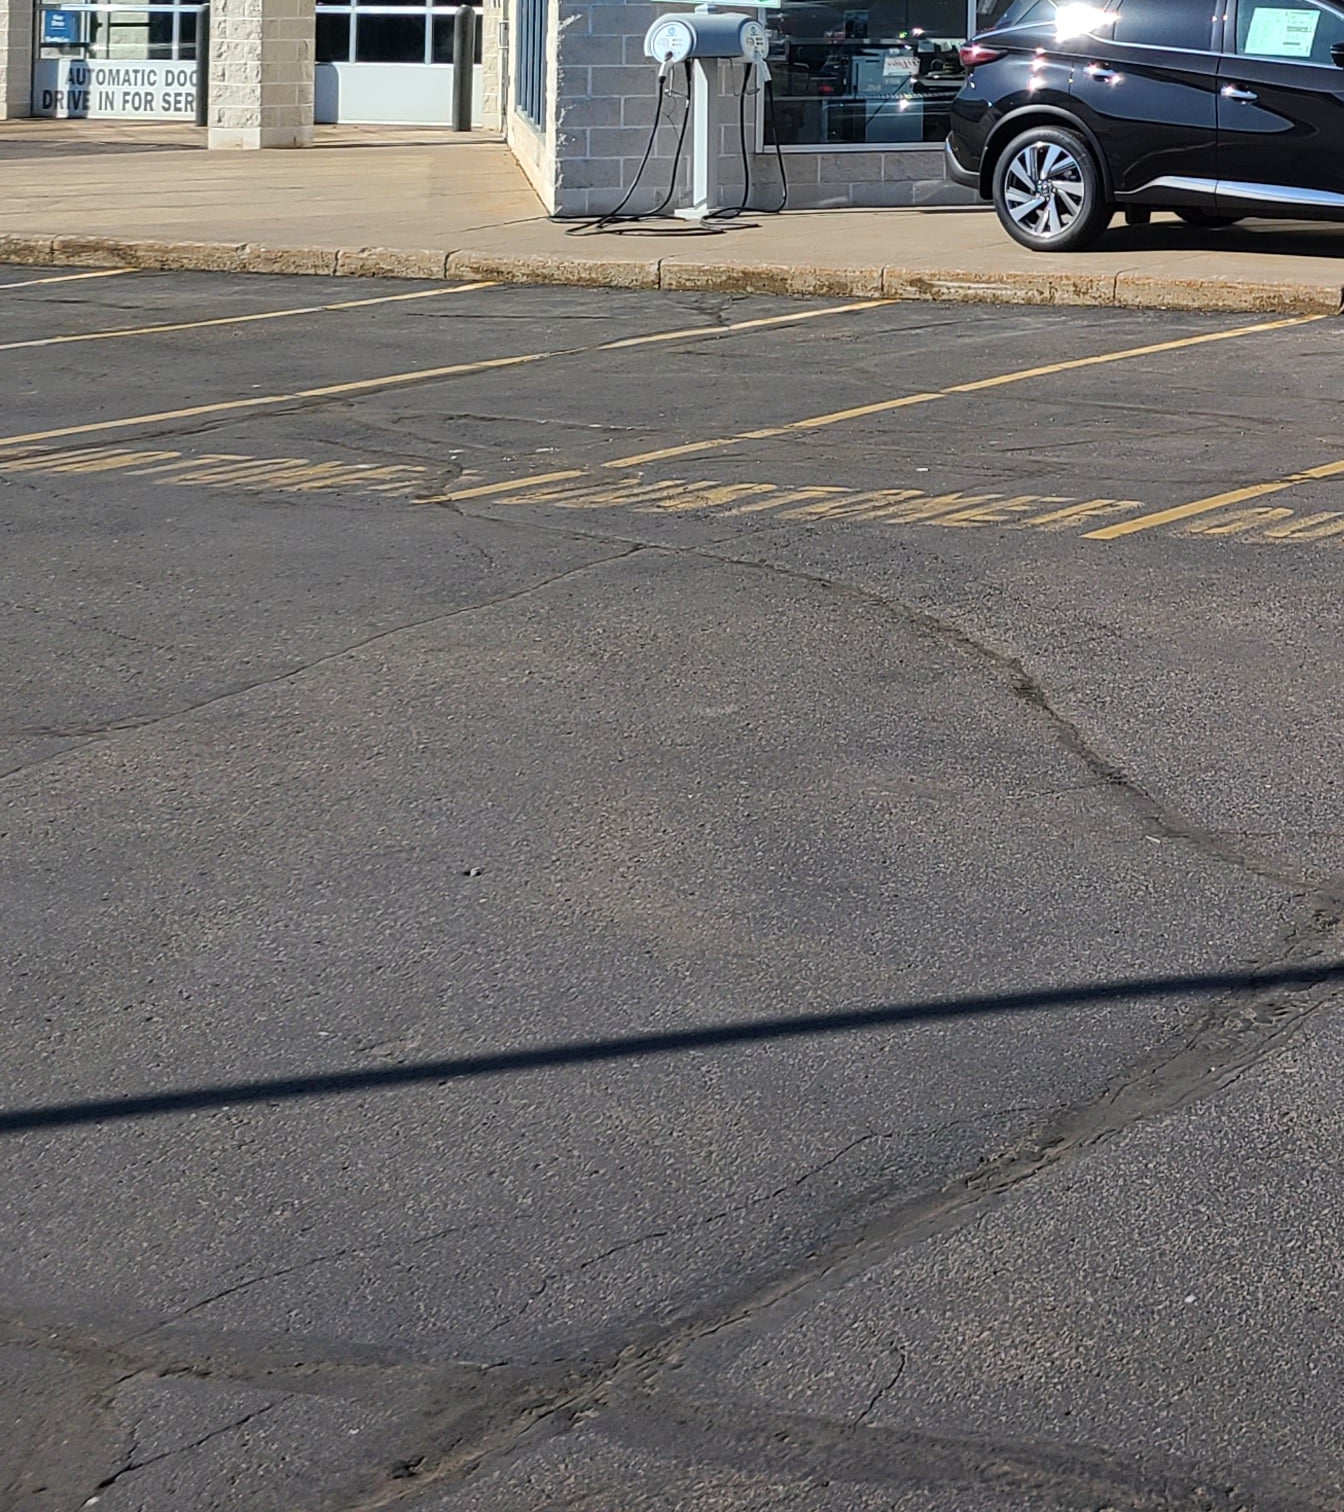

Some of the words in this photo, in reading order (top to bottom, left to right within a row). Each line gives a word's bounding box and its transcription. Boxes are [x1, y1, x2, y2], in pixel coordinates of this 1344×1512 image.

[65, 68, 158, 88] AUTOMATIC
[42, 89, 92, 111] DRIVE
[98, 90, 116, 111] IN
[121, 91, 155, 112] FOR
[493, 478, 1146, 531] CUSTOMER
